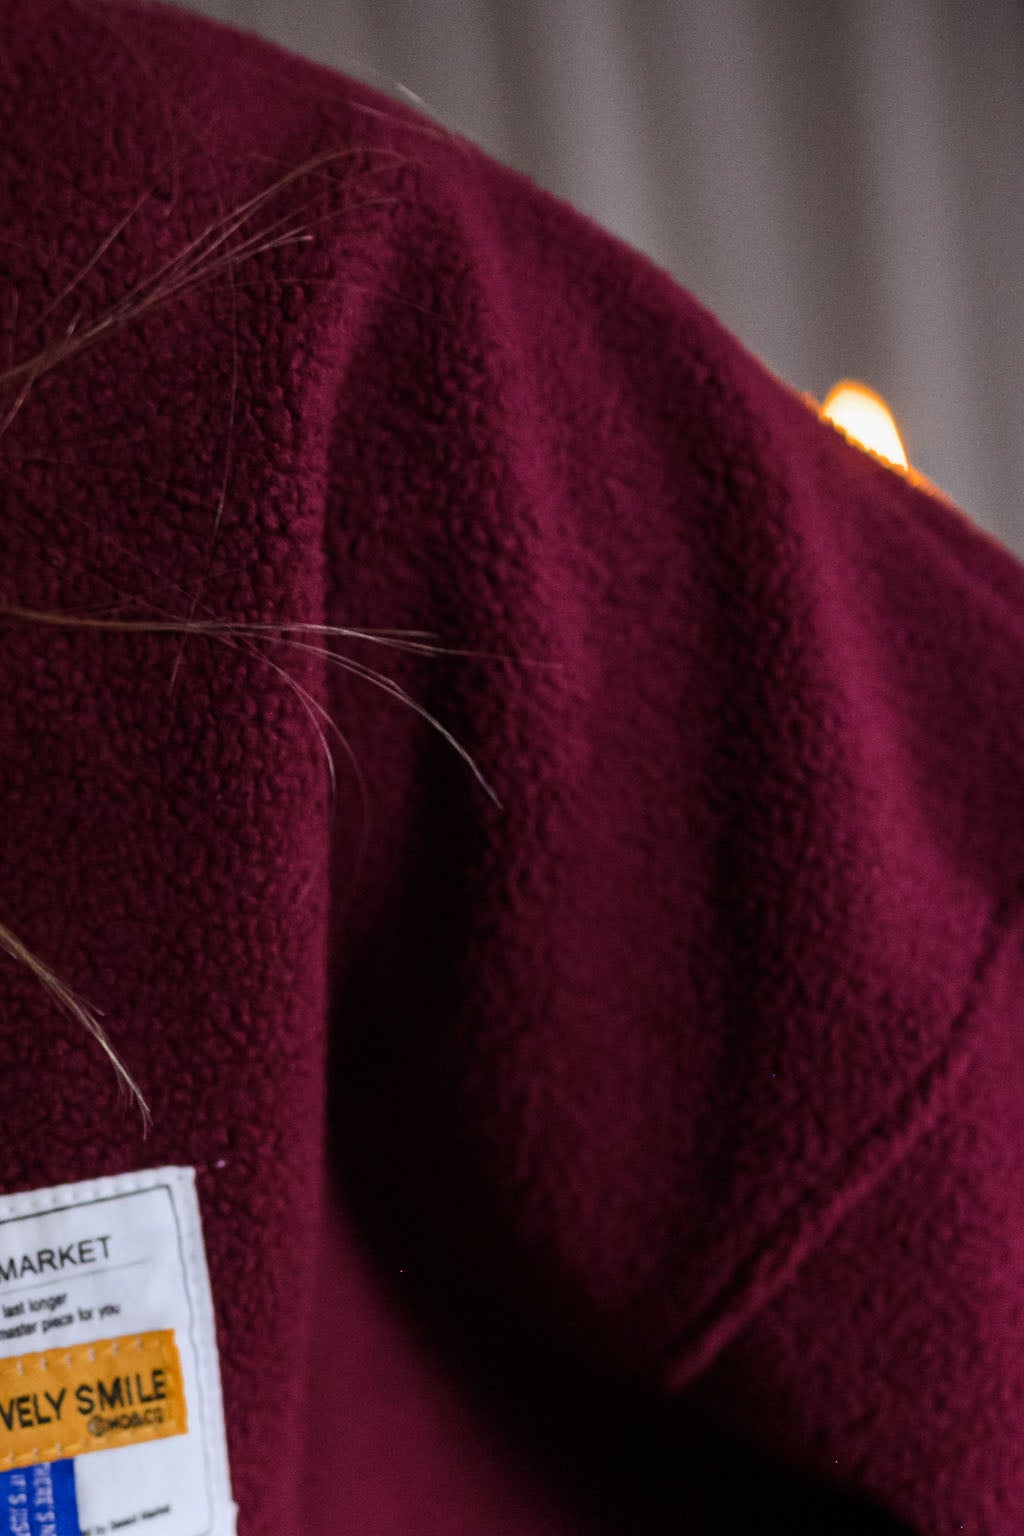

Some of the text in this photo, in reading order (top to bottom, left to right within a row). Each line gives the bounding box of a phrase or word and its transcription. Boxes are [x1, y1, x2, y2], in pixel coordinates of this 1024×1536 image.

[2, 1302, 25, 1318] last
[29, 1292, 68, 1312] longer
[41, 1312, 75, 1334] piece
[77, 1307, 93, 1321] for
[98, 1304, 121, 1320] you
[74, 1368, 167, 1416] SMILE
